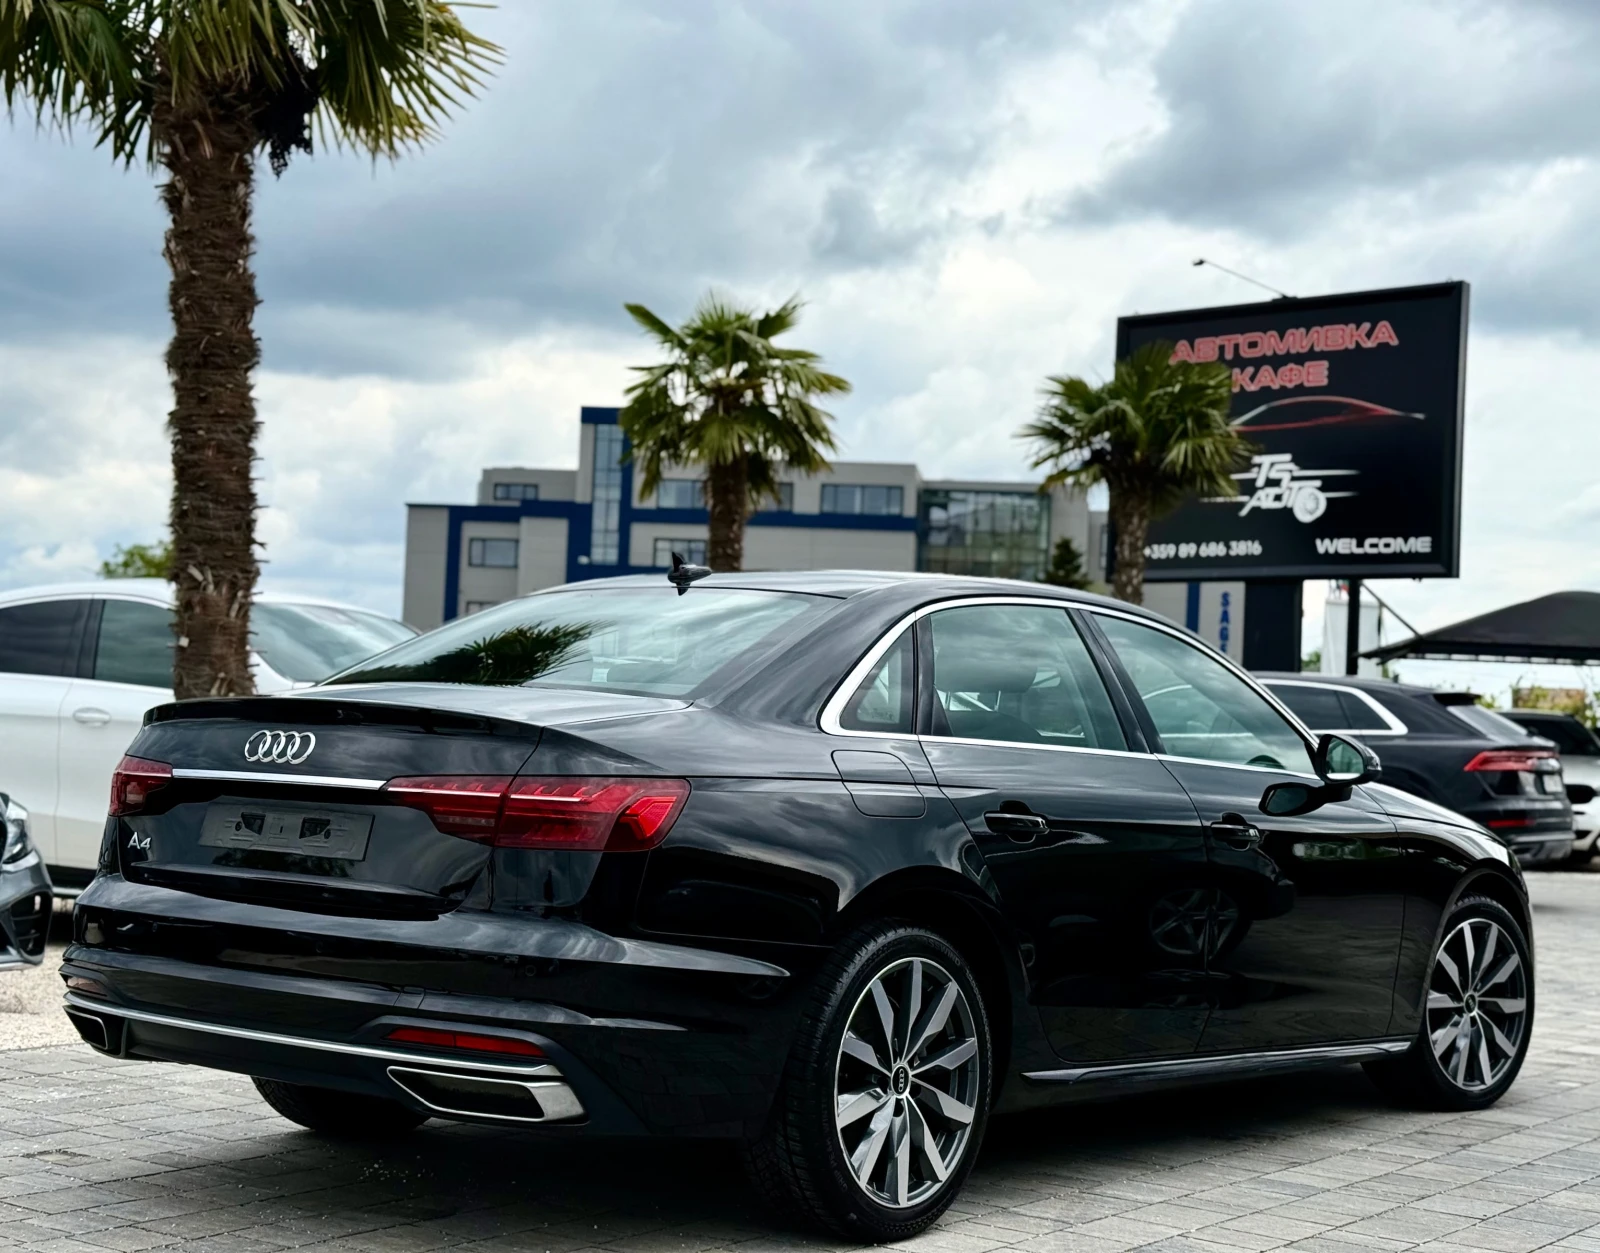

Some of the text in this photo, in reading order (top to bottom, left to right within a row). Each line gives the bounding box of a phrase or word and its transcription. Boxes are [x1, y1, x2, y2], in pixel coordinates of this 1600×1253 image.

[1168, 320, 1399, 365] АВТОМИВКА
[1231, 360, 1329, 392] КАФЕ
[1178, 542, 1197, 558] 89
[1199, 541, 1227, 557] 686
[1229, 540, 1263, 556] 3816
[1315, 536, 1432, 554] WELCOME
[127, 831, 152, 851] A4
